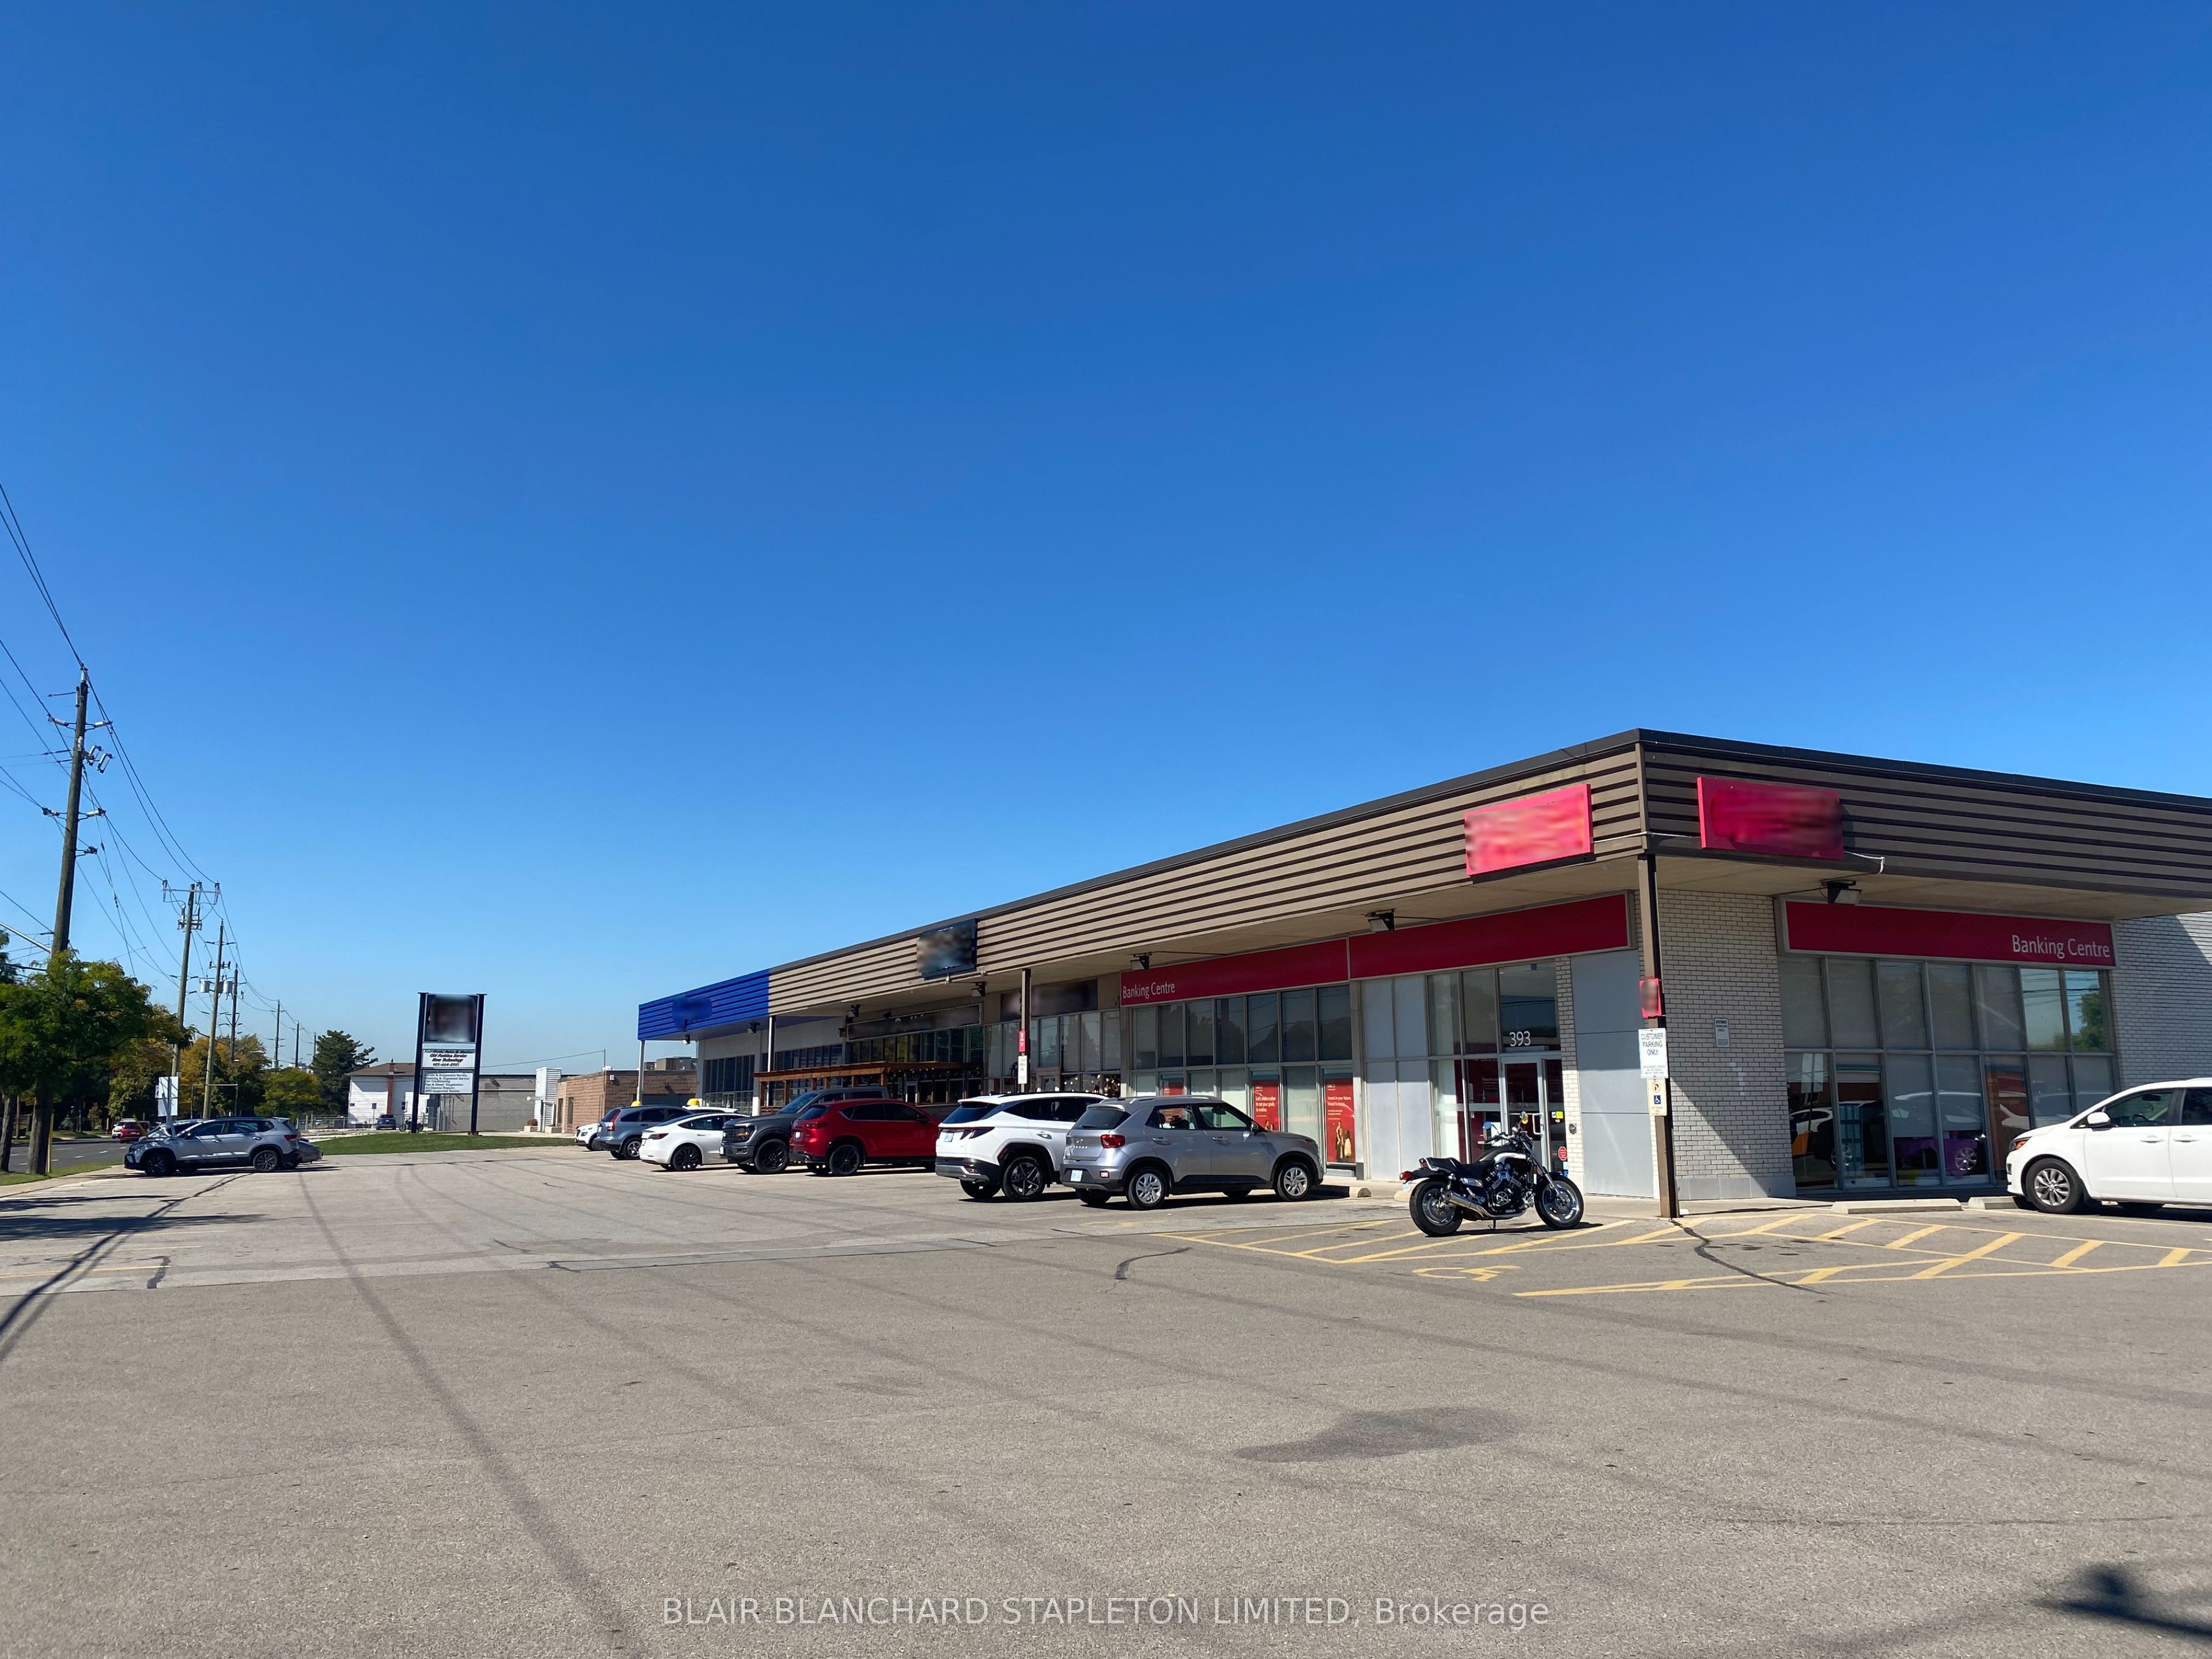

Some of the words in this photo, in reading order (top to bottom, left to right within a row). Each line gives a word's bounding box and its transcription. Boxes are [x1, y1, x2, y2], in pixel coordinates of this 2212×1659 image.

[2012, 934, 2065, 959] Banking
[2067, 938, 2111, 958] Centre
[1123, 984, 1150, 999] Banking
[1151, 981, 1176, 995] Centre
[1509, 1031, 1531, 1047] 393
